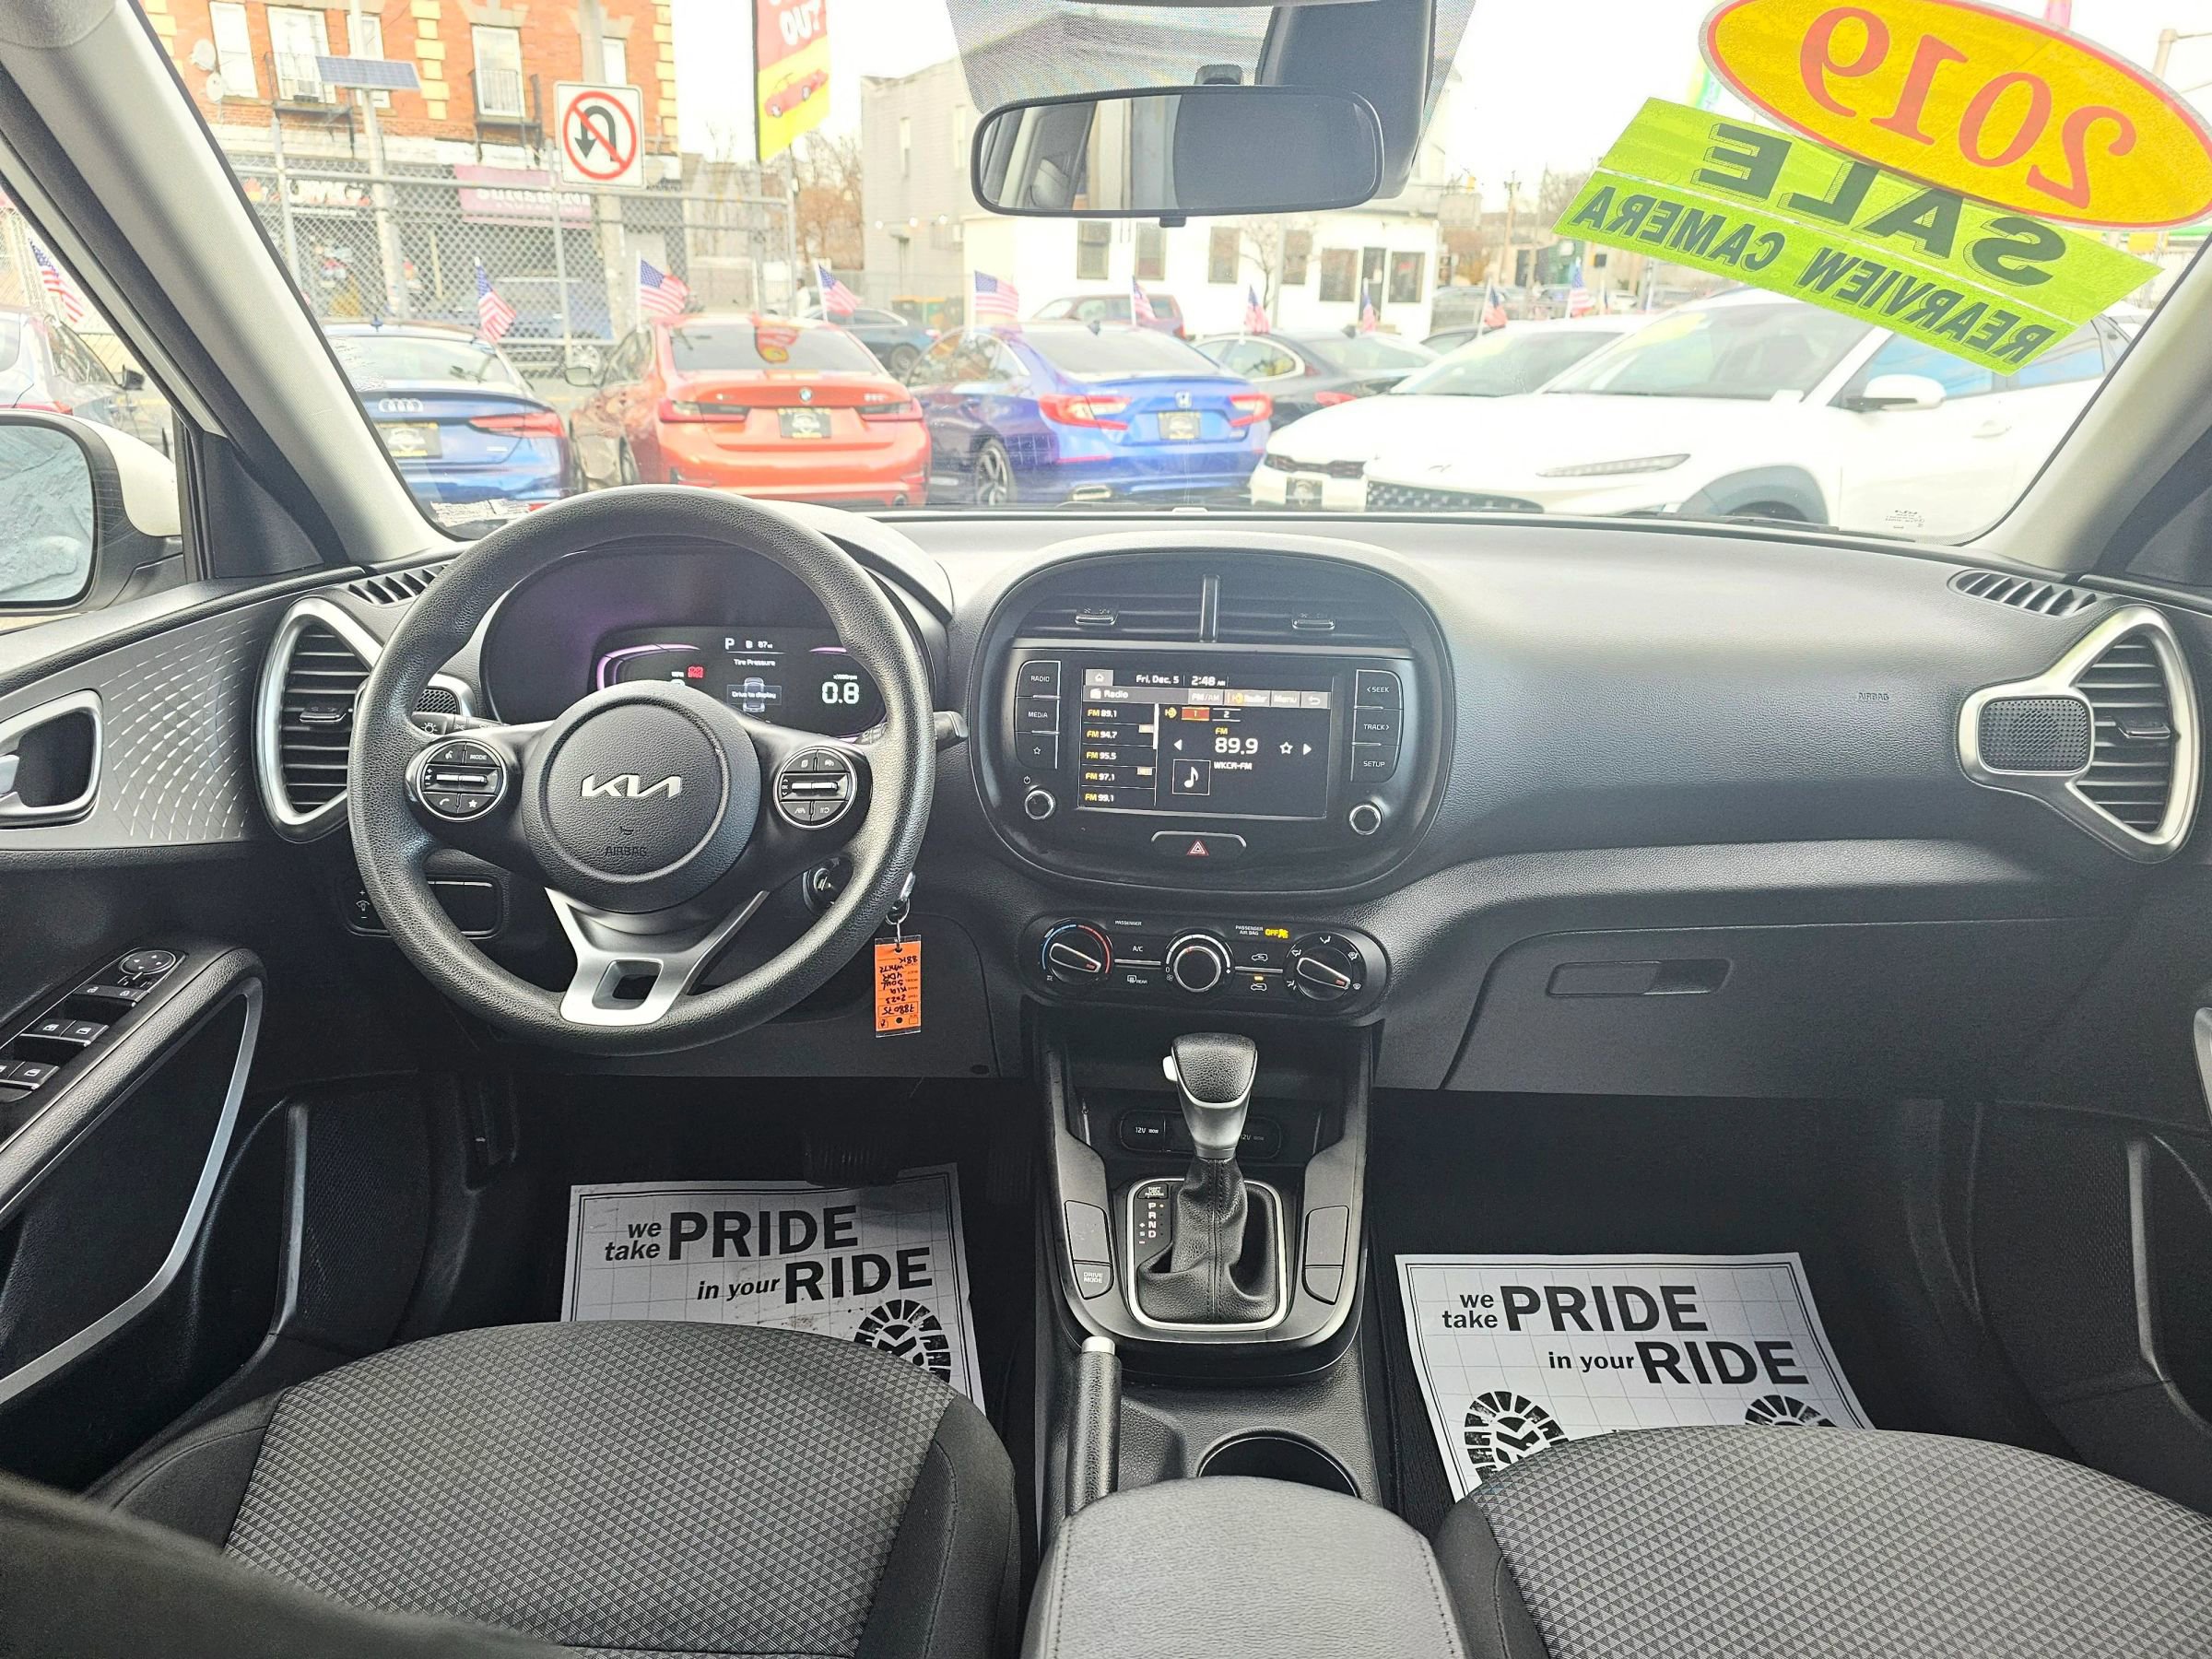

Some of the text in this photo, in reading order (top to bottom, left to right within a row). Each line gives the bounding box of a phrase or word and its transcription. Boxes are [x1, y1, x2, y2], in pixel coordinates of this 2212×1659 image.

[724, 638, 735, 651] P
[1172, 676, 1180, 684] 5
[1191, 676, 1216, 687] 2:48
[821, 681, 860, 705] 0.8
[1104, 689, 1129, 699] Radio
[1191, 692, 1220, 702] FM/AM
[1857, 691, 1890, 701] AIRBAG
[1273, 694, 1298, 703] Menu
[1087, 709, 1100, 717] FM
[1086, 730, 1118, 739] FM 94.7
[1215, 727, 1229, 735] FM
[1214, 736, 1259, 756] 89.9
[1086, 751, 1117, 760] FM 95.5
[1085, 771, 1115, 782] FM 97.1
[1084, 793, 1097, 801] FM
[605, 846, 647, 857] AIRBAG
[1265, 928, 1278, 936] OFF
[1147, 1202, 1157, 1210] P
[628, 1221, 662, 1238] we
[1147, 1220, 1157, 1229] N
[605, 1205, 859, 1262] take PRIDE
[1147, 1230, 1157, 1238] D
[697, 1246, 934, 1305] in your RIDE
[1460, 1292, 1495, 1309] we
[1441, 1285, 1709, 1333] take PRIDE
[1548, 1340, 1810, 1385] in your RIDE
